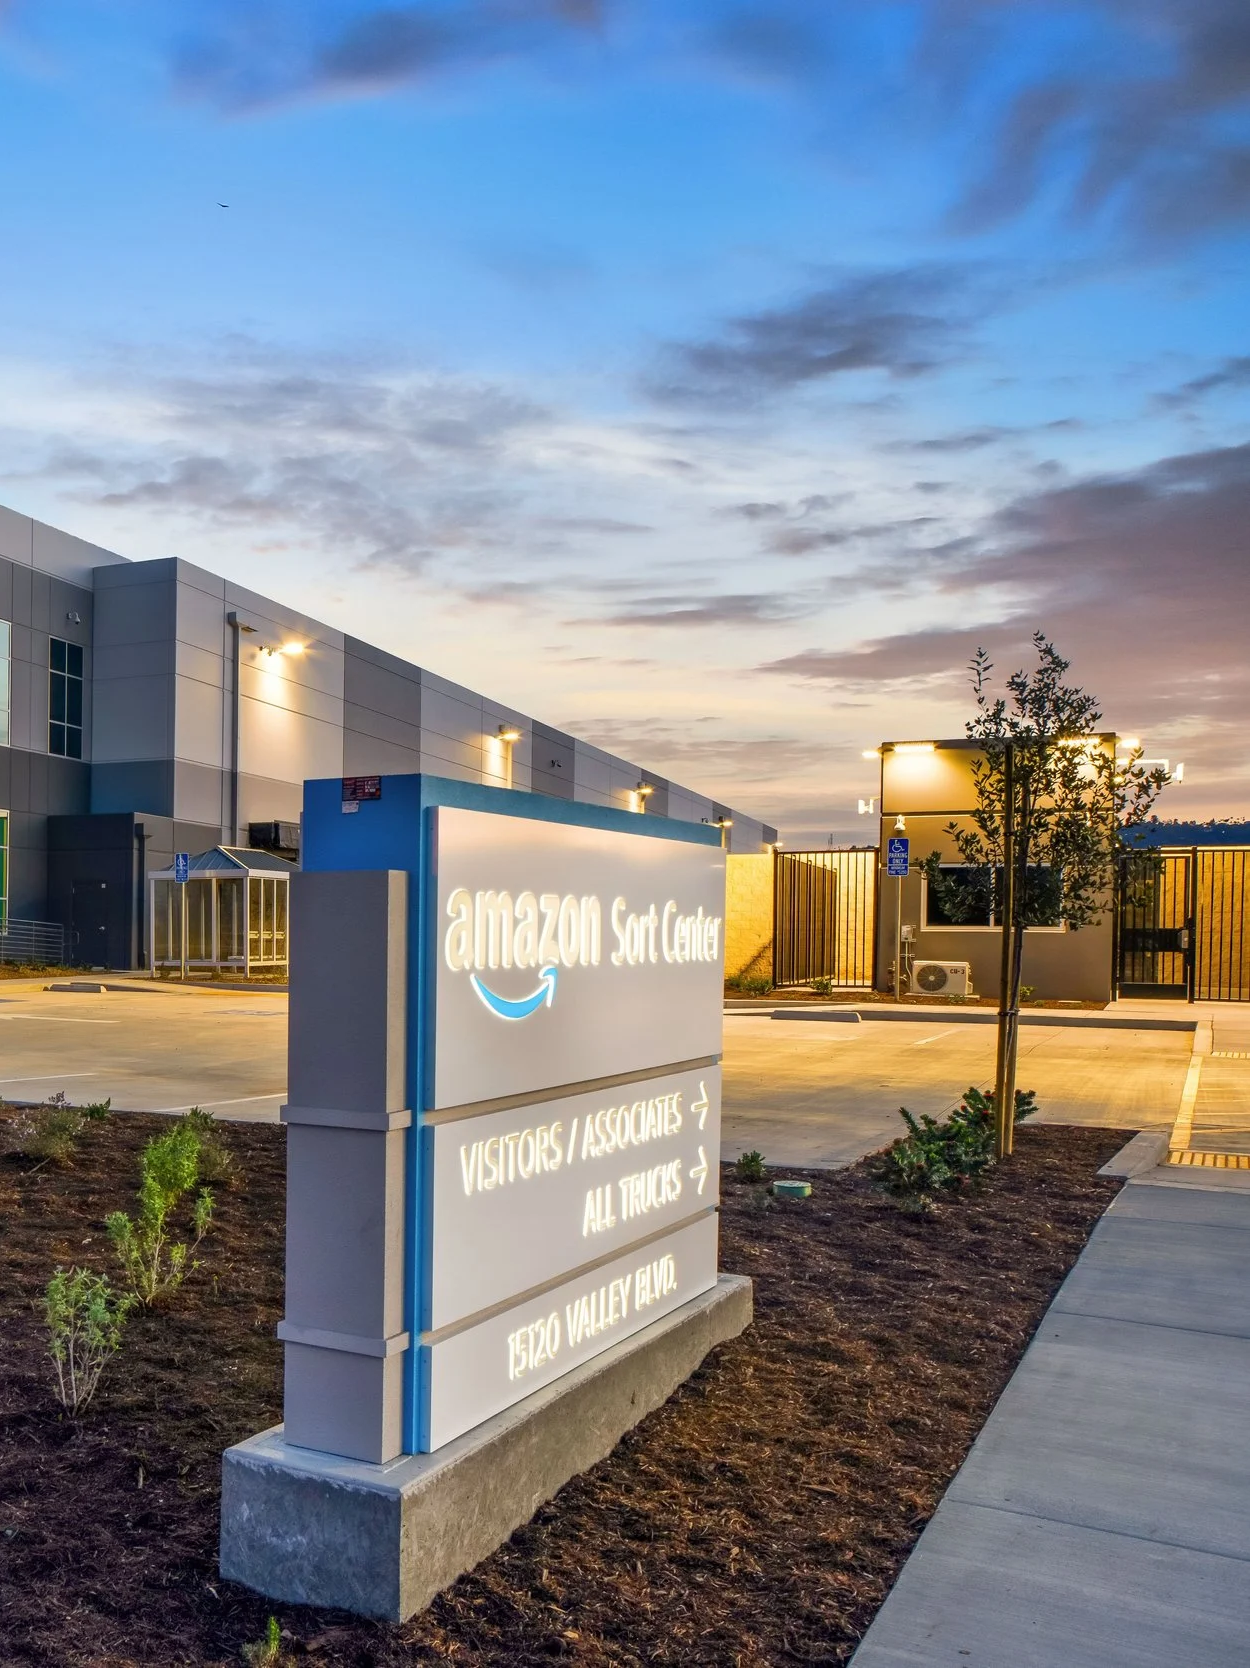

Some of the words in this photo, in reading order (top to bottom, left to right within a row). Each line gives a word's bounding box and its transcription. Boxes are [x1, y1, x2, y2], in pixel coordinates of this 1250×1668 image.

[445, 888, 601, 971] amazon
[611, 897, 658, 966] Sort
[662, 899, 723, 964] Center
[459, 1121, 563, 1196] VISITORS
[581, 1092, 683, 1160] ASSOCIATES
[582, 1183, 616, 1238] ALL
[619, 1159, 682, 1222] TRUCKS
[507, 1312, 562, 1381] 15120
[565, 1274, 632, 1348] VALLEY
[635, 1254, 678, 1308] BLVD.
